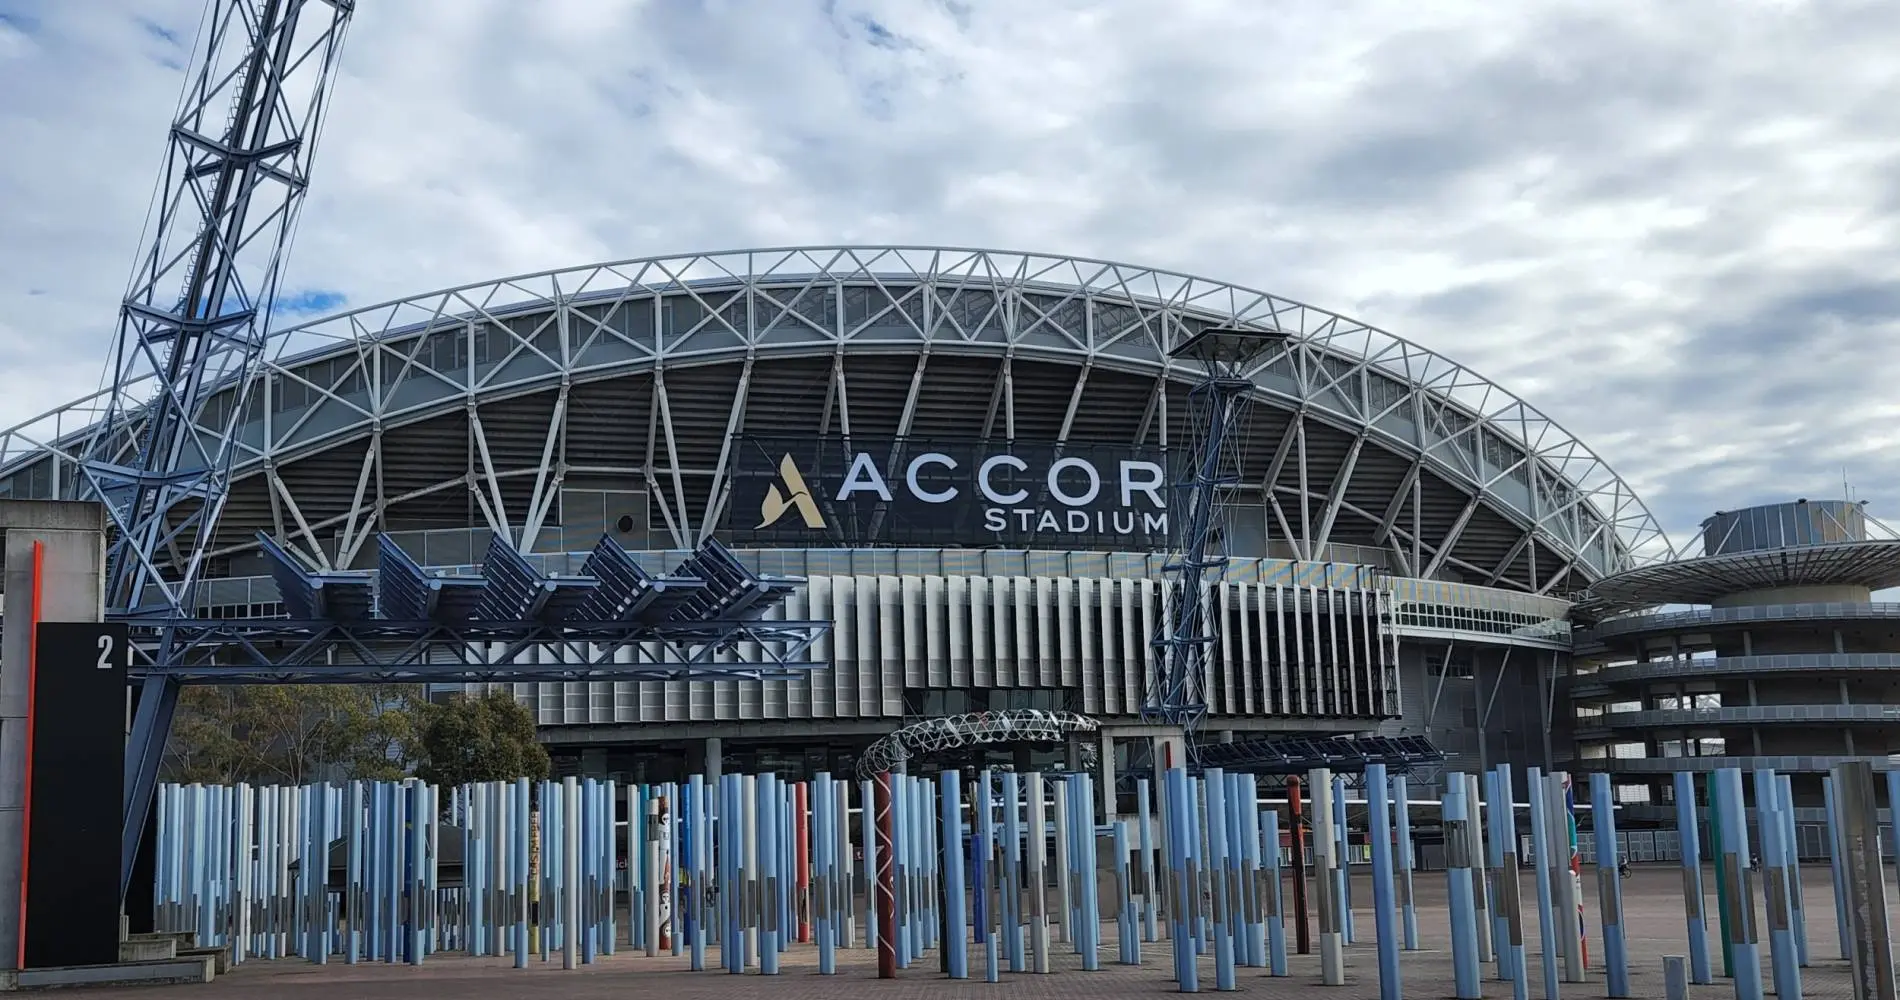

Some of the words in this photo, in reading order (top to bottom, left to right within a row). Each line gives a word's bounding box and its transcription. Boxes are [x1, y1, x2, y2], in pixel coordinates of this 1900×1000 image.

[836, 452, 1167, 507] ACCOR
[984, 508, 1168, 535] STADIUM
[97, 634, 113, 669] 2
